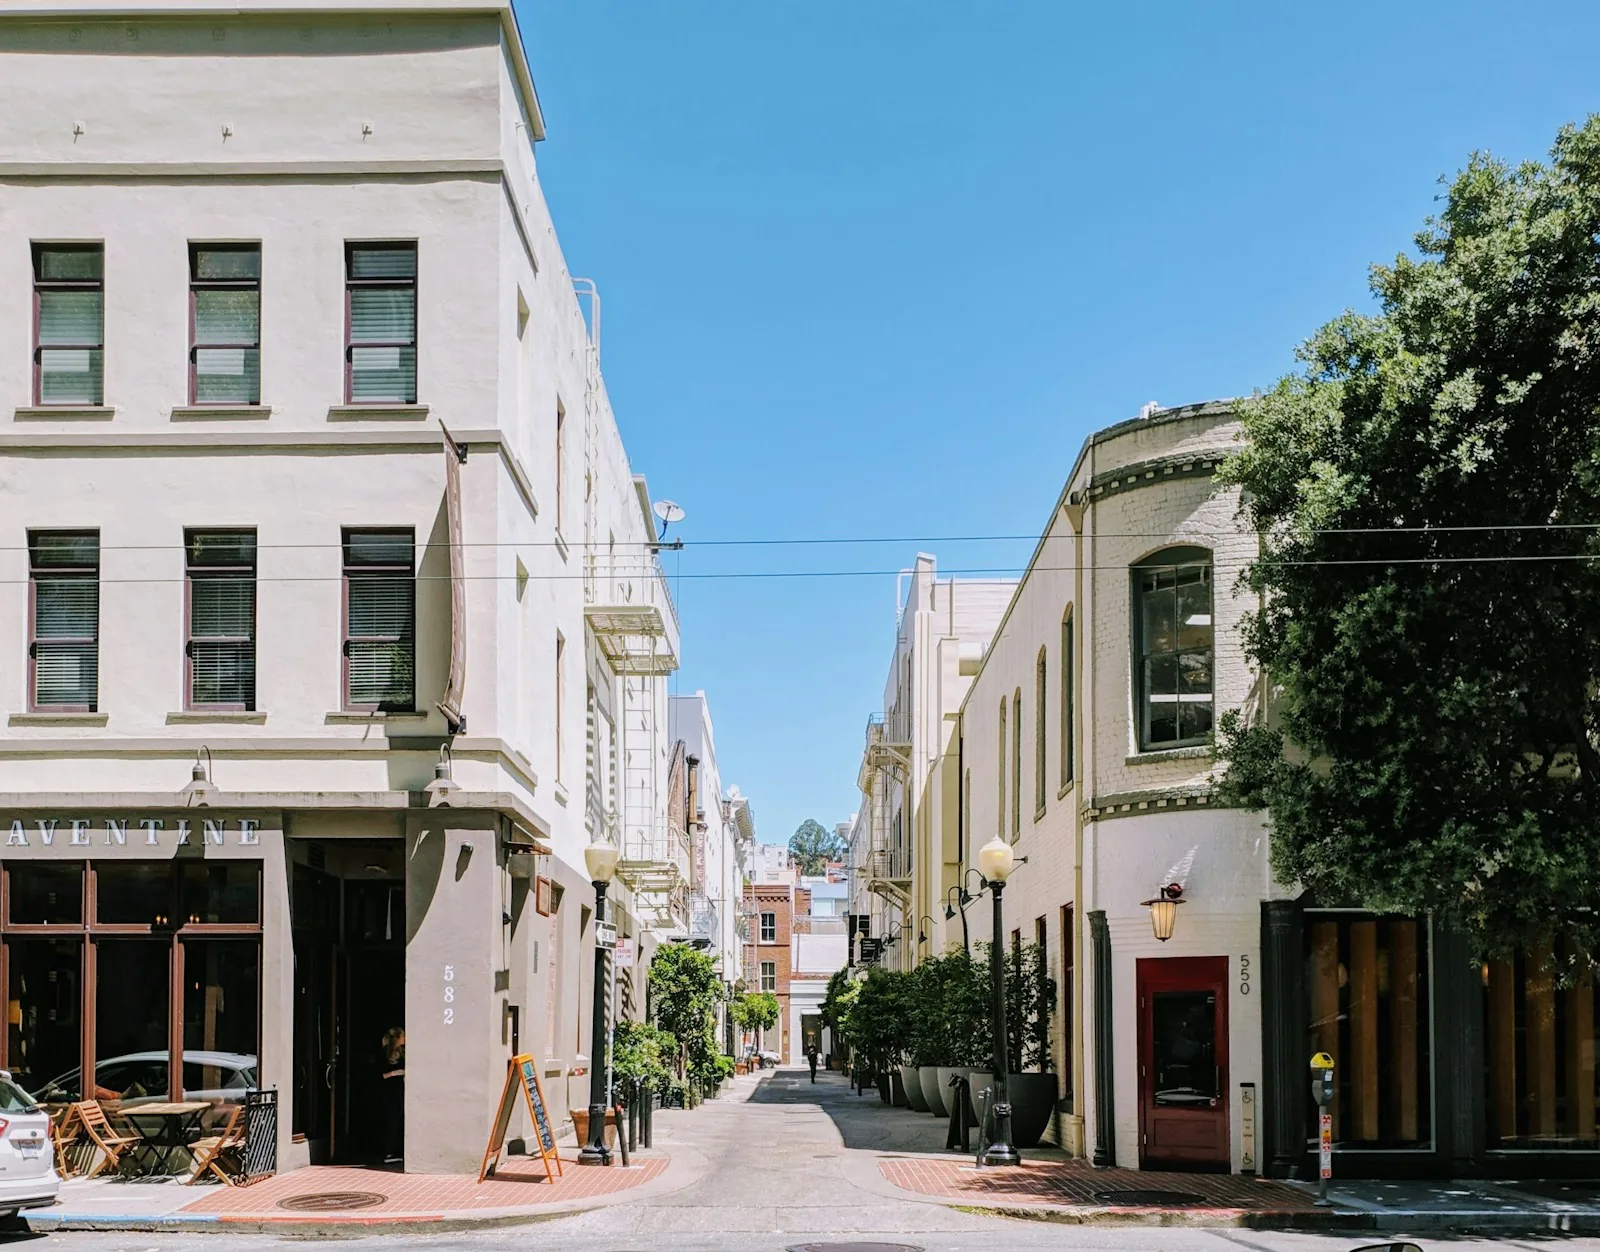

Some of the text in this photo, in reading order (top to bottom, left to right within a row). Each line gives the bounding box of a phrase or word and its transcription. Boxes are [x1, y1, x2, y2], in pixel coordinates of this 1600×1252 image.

[5, 818, 262, 847] AVENTINE
[443, 965, 455, 1025] 582
[1240, 954, 1250, 995] 550
